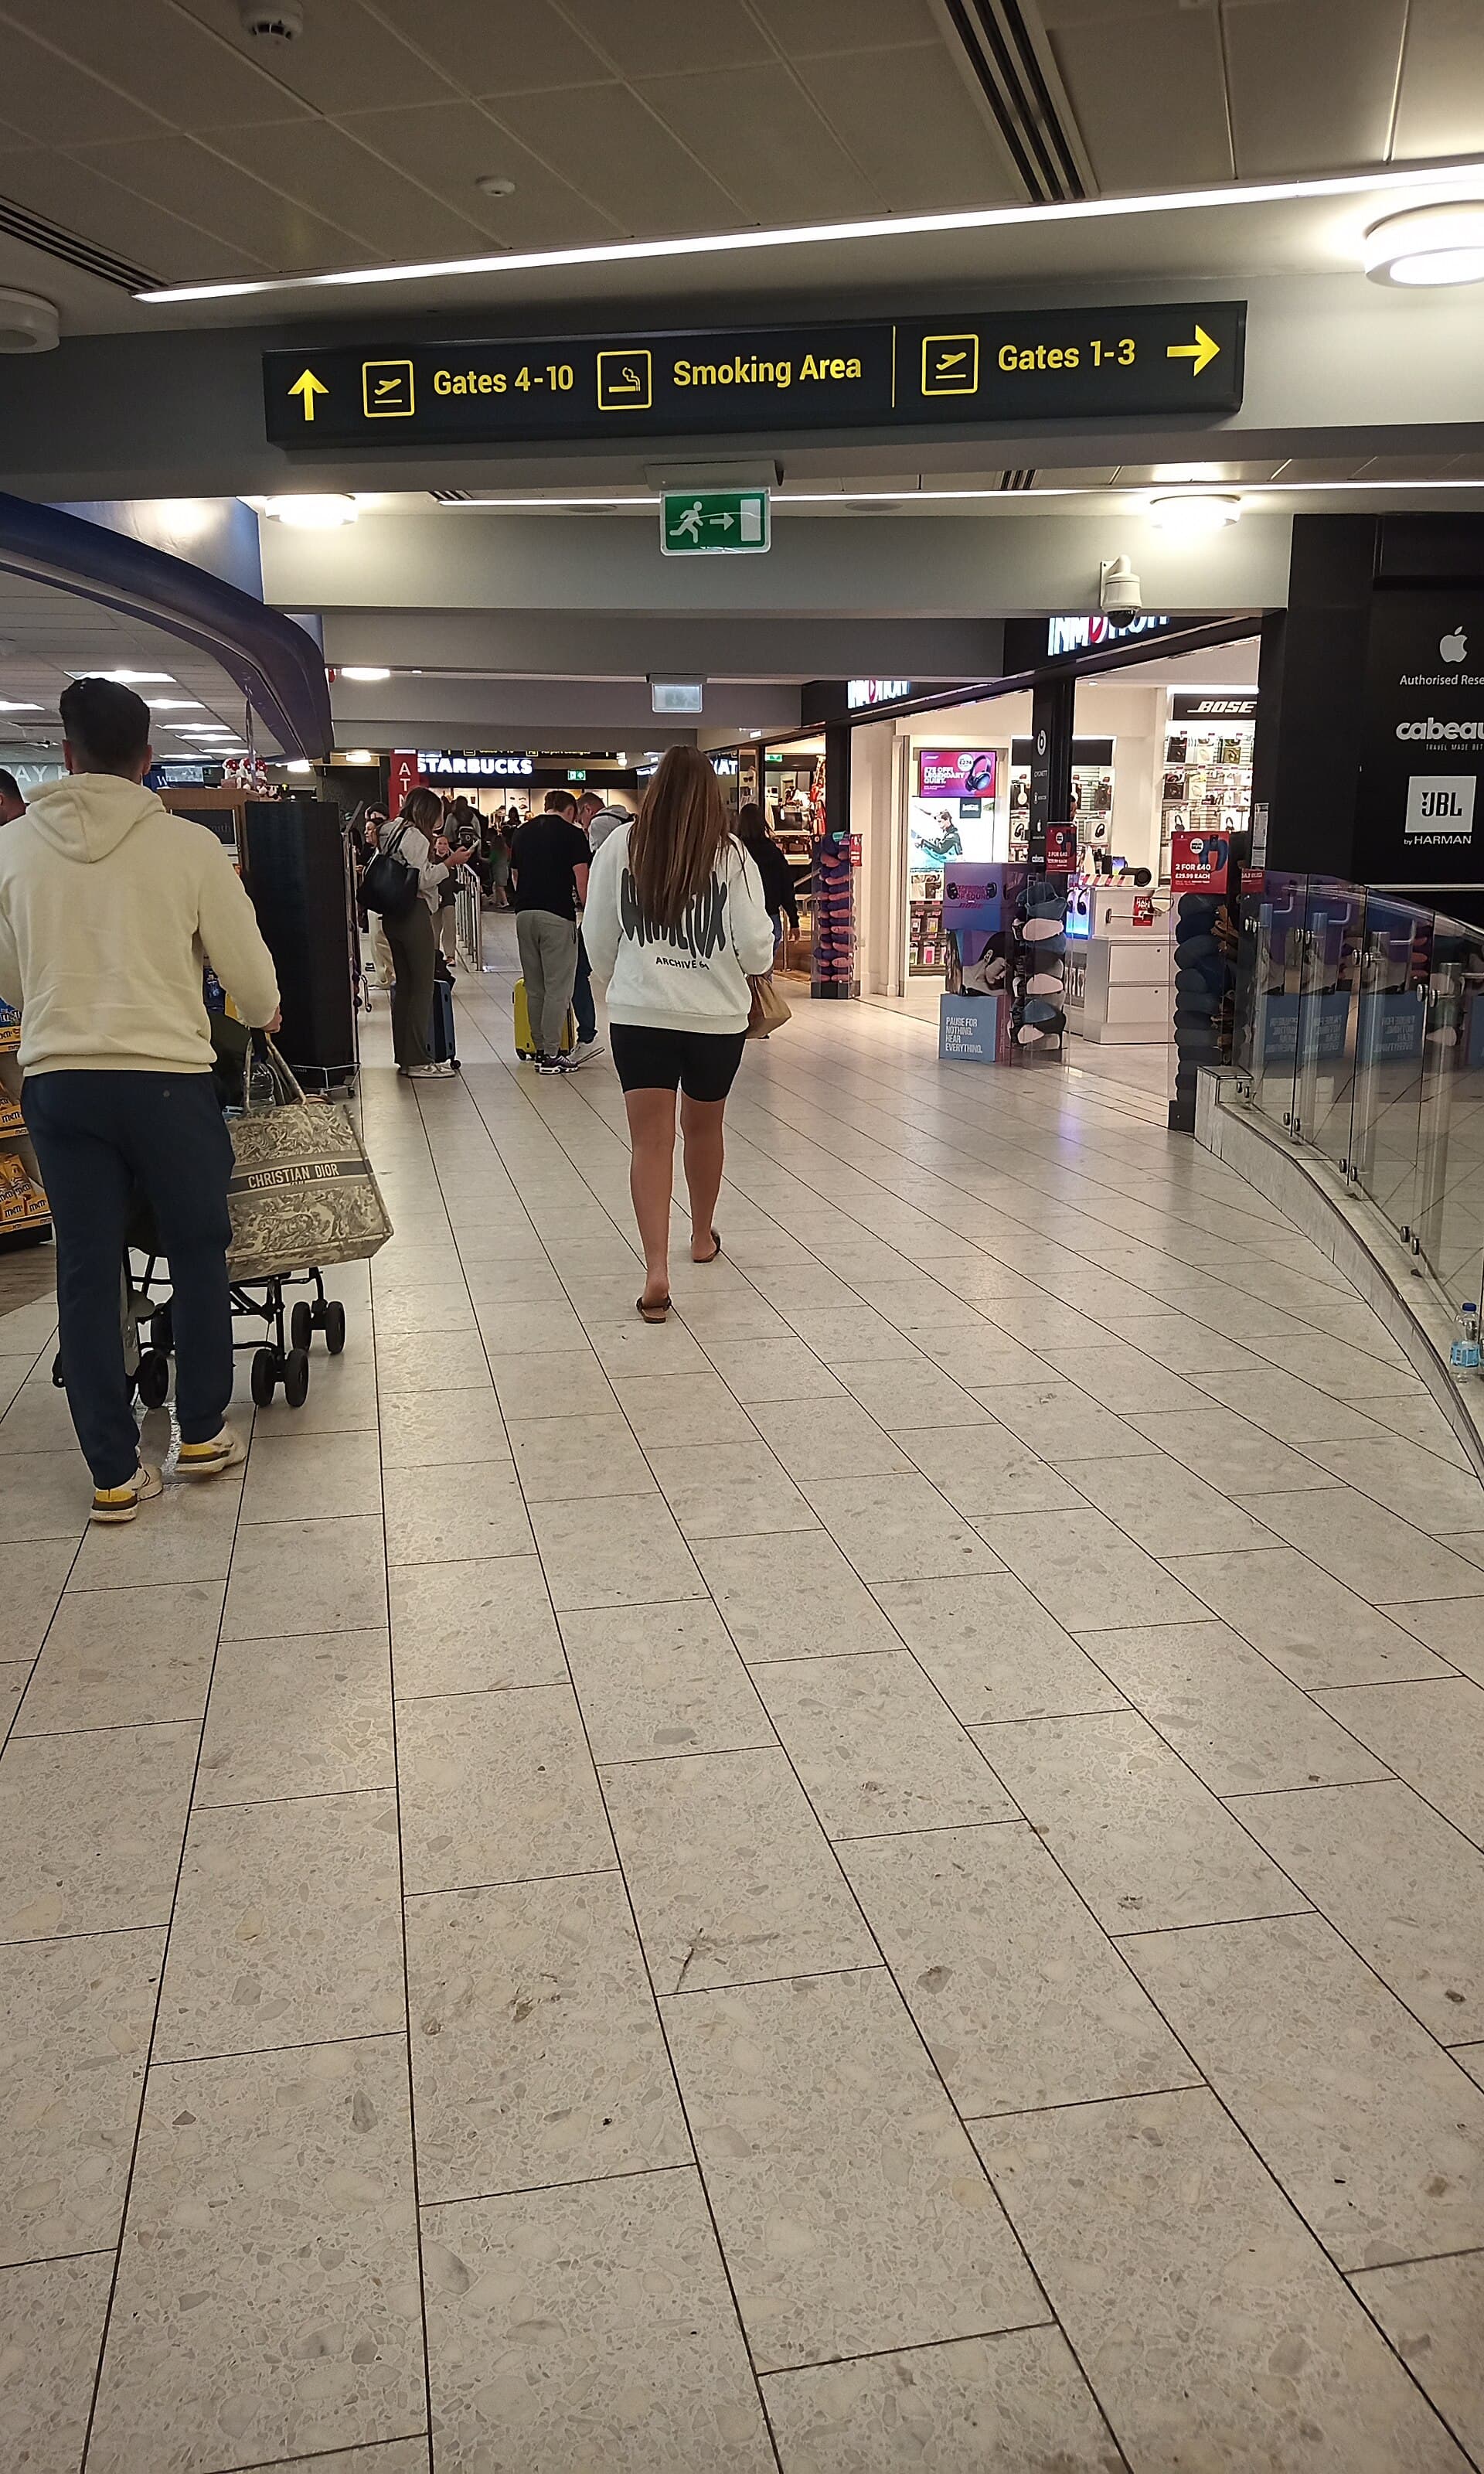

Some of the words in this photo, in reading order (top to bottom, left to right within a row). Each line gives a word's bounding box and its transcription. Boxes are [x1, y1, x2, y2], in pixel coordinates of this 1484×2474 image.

[999, 345, 1080, 371] Gates
[1091, 339, 1135, 366] 1-3
[673, 355, 791, 388] Smoking
[800, 354, 862, 380] Area
[434, 370, 507, 395] Gates
[514, 365, 574, 392] 4-10
[1400, 674, 1458, 685] Authorised
[1187, 700, 1258, 713] BOSE
[417, 758, 533, 774] STARBUCKS
[1422, 792, 1462, 816] JBL
[1414, 836, 1472, 844] HARMAN
[656, 956, 697, 969] ARCHIVE
[946, 1017, 965, 1026] PAUSE
[965, 1018, 978, 1027] FOR
[945, 1026, 973, 1035] NOTHING.
[945, 1034, 961, 1043] HEAR
[945, 1043, 983, 1053] EVERYTHING.
[248, 1166, 311, 1188] CHRISTIAN
[315, 1163, 340, 1177] DIOR
